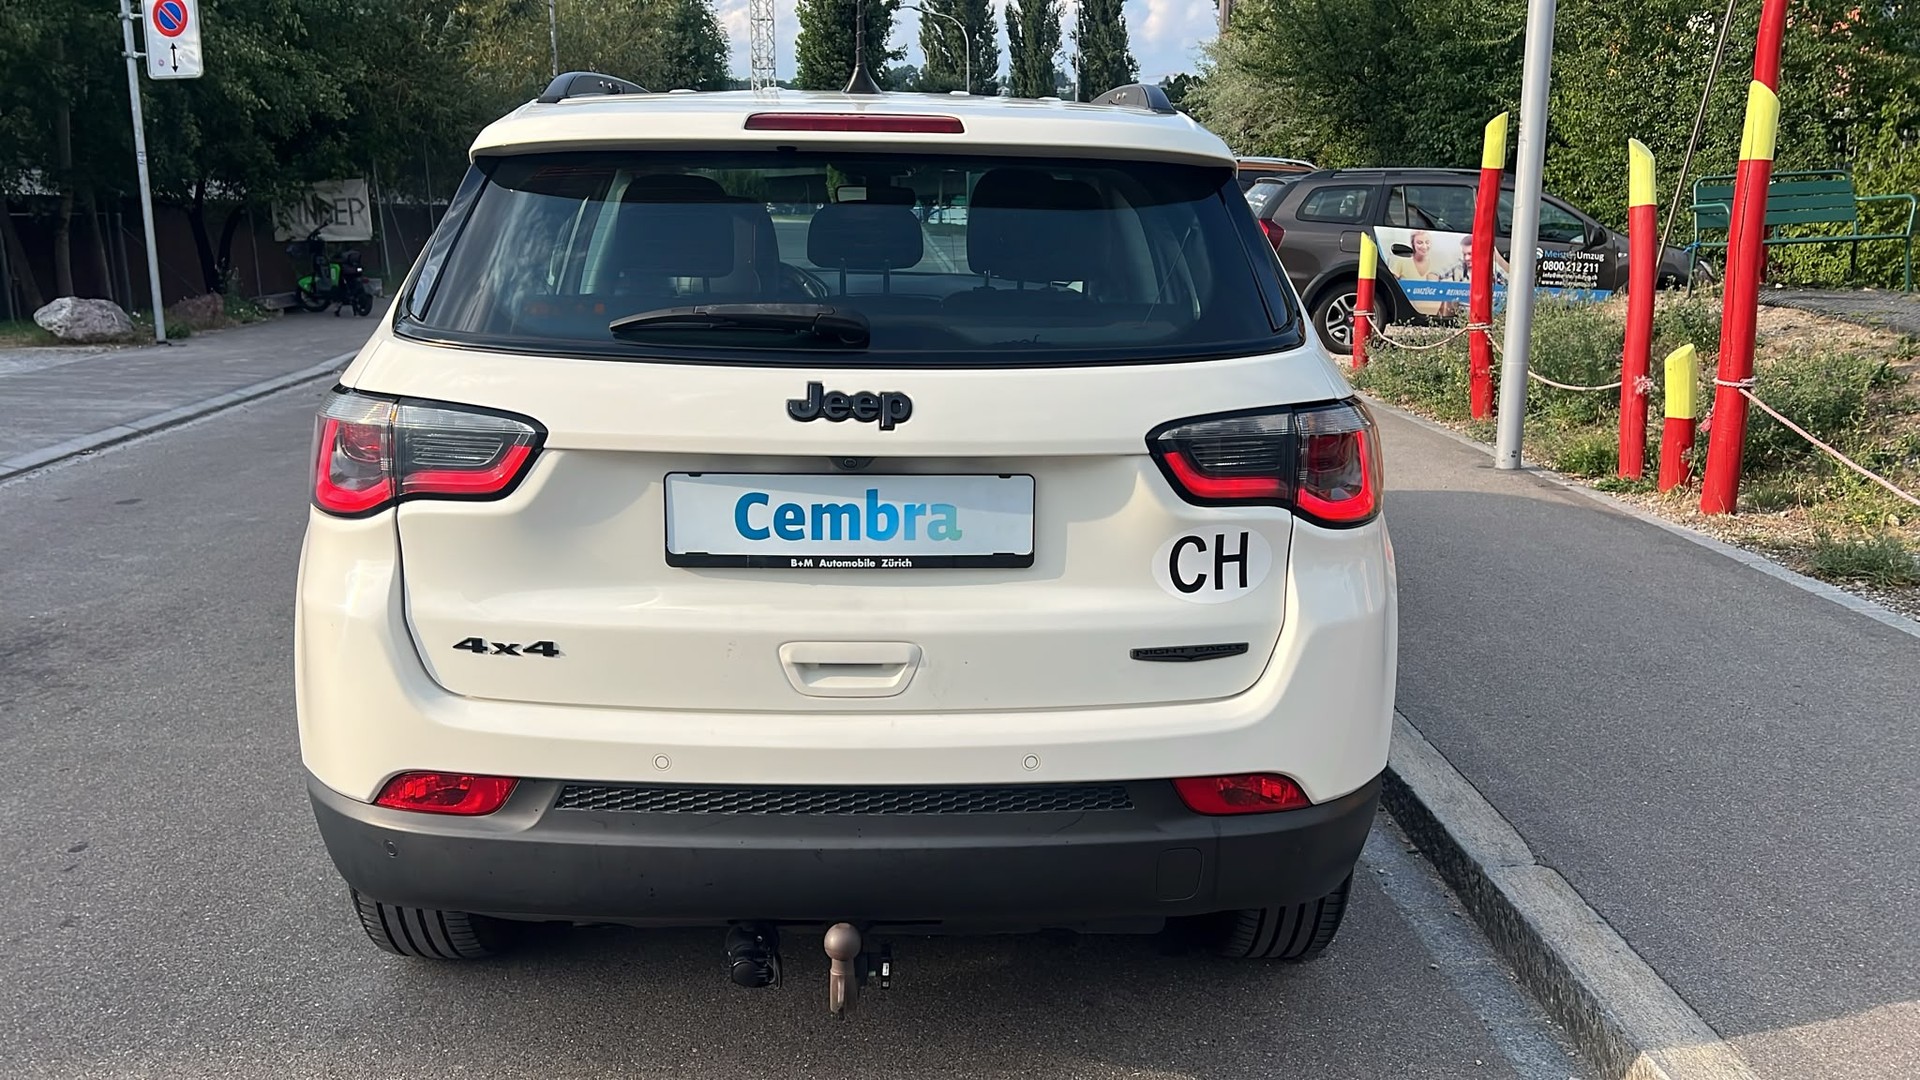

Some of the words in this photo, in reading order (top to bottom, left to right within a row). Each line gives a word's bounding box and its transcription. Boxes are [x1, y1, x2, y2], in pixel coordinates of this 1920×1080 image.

[1542, 260, 1565, 271] 0800
[1566, 261, 1582, 272] 212
[1583, 263, 1599, 273] 211
[1446, 288, 1471, 297] REINIGU
[786, 381, 913, 430] Jeep
[790, 558, 814, 568] B+M
[819, 558, 876, 568] Automobile
[881, 557, 912, 568] Zürich
[1169, 532, 1249, 593] CH
[452, 637, 562, 657] 4x4
[1136, 648, 1187, 657] NIGHT
